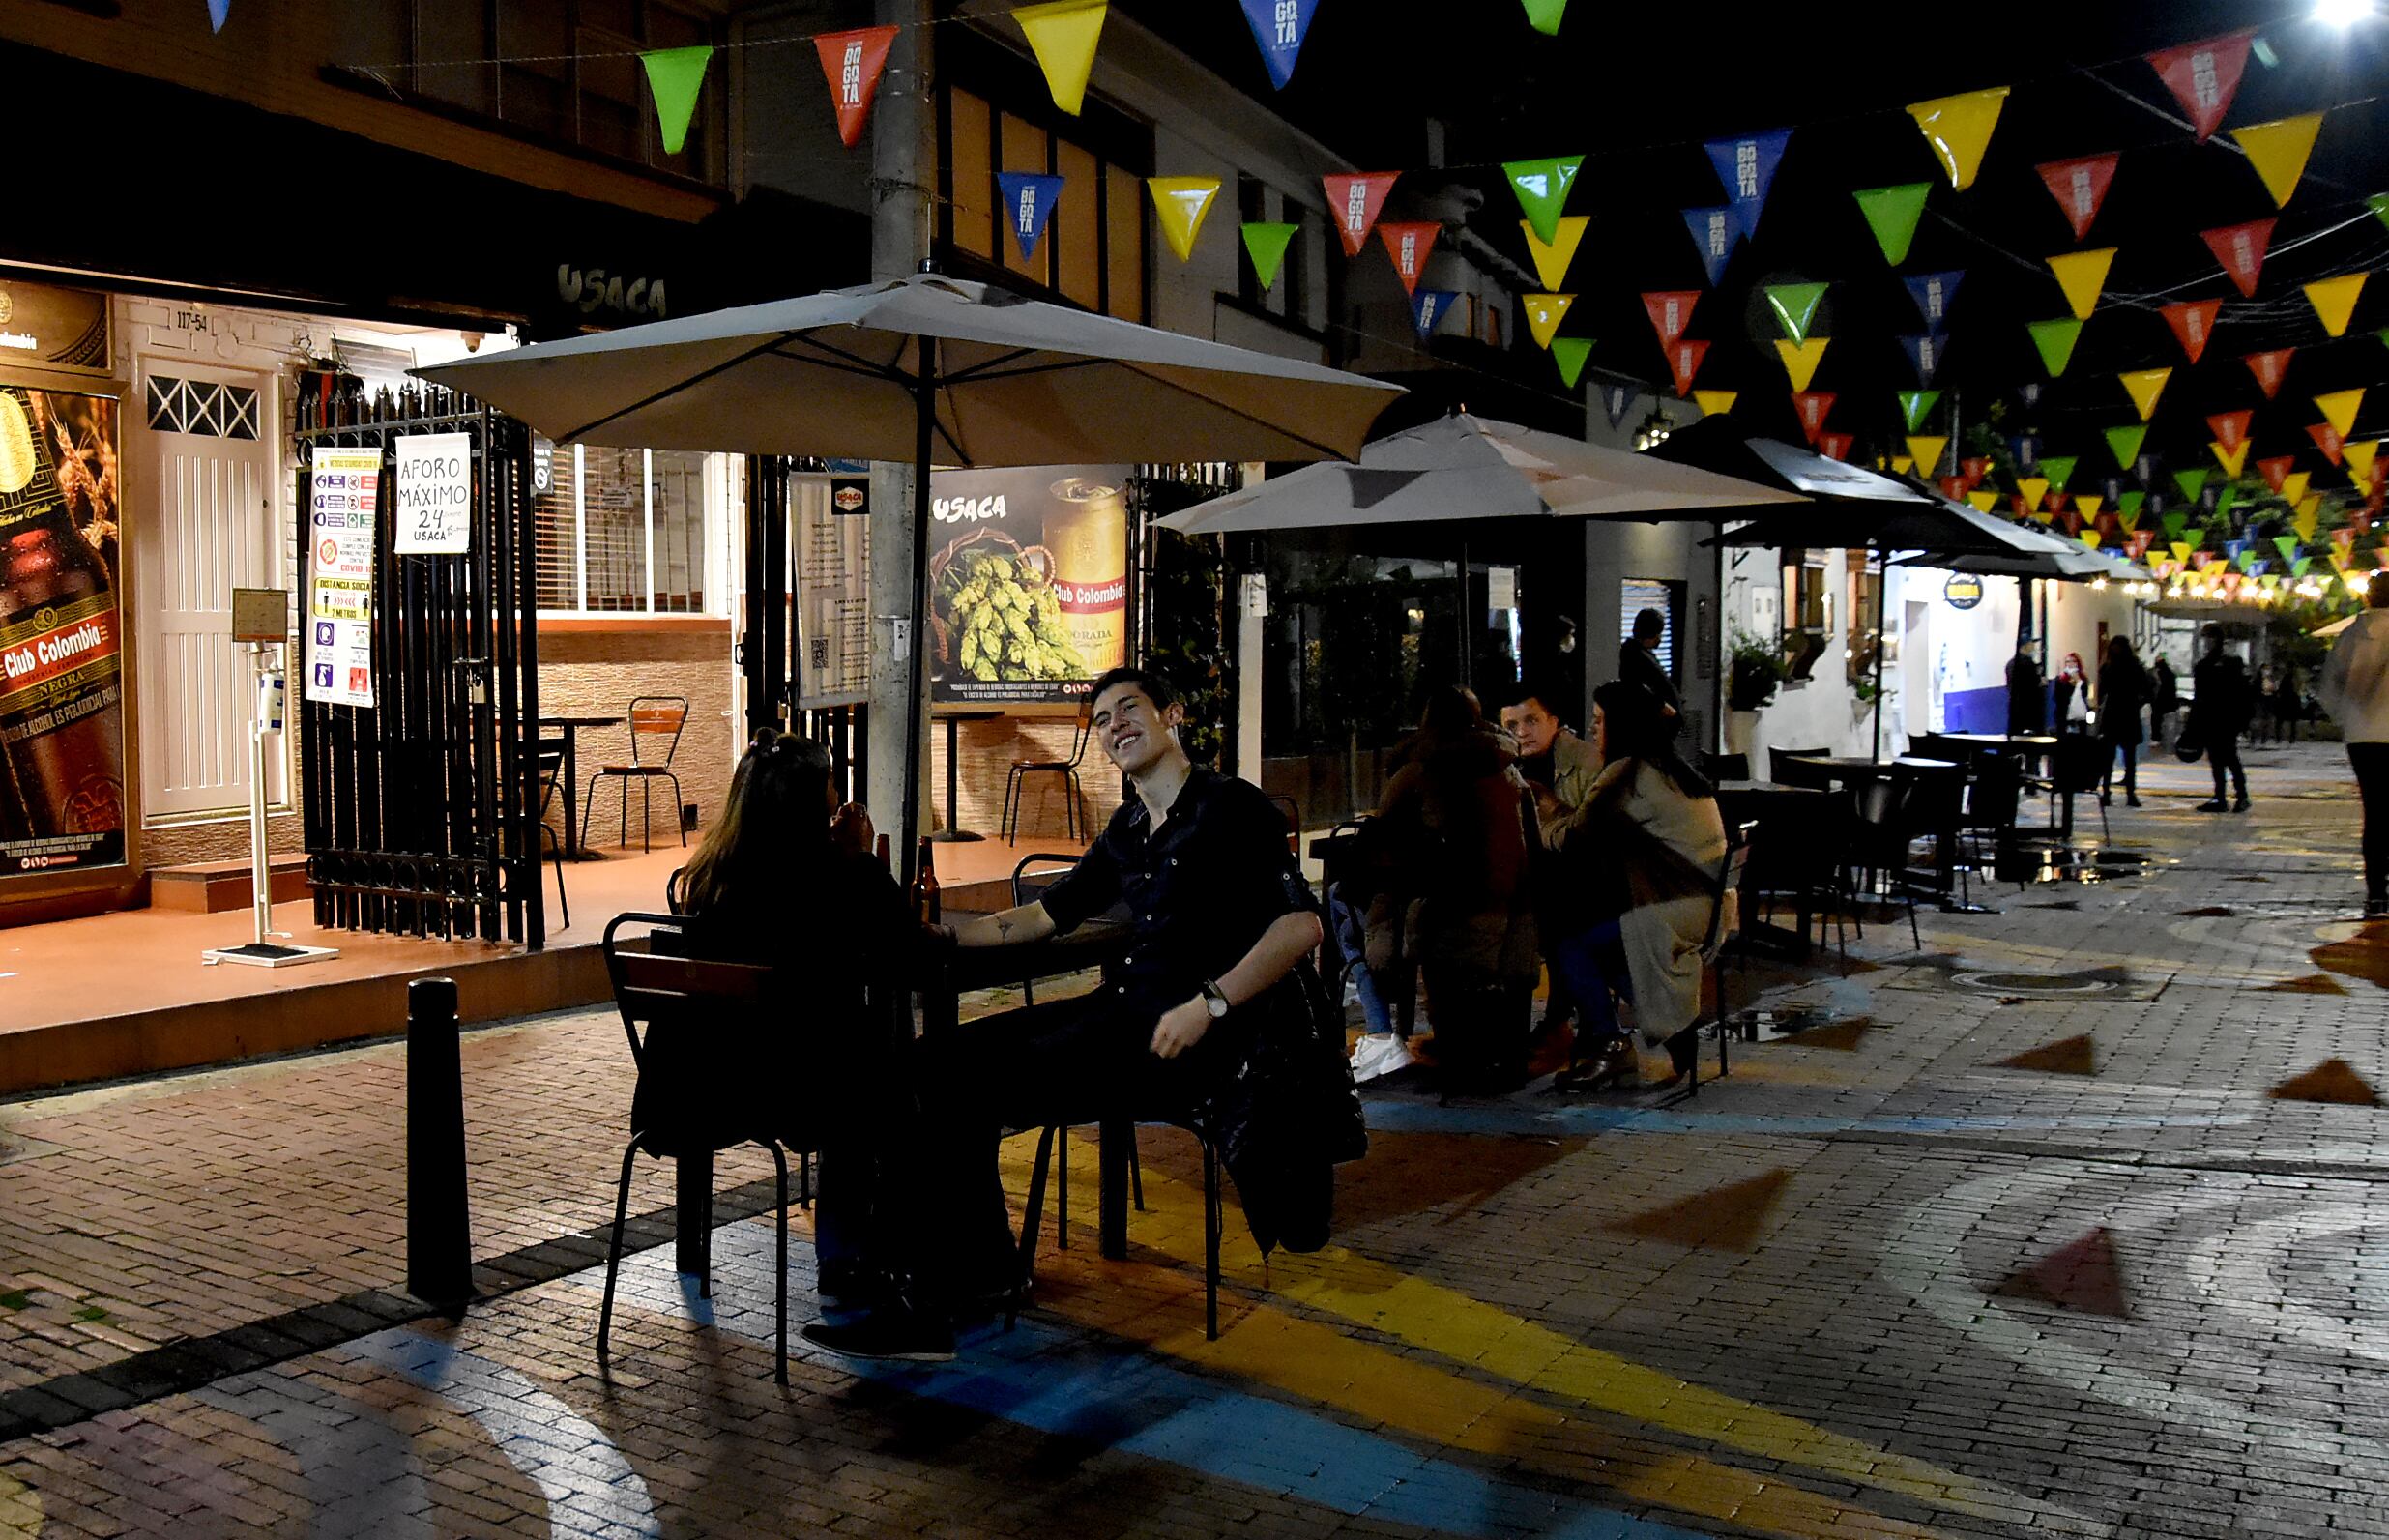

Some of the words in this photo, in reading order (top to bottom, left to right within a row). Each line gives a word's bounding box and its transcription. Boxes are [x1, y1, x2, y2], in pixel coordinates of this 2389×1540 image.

[844, 46, 861, 66] BO
[1021, 190, 1034, 204] BO
[1350, 185, 1365, 199] BO
[558, 263, 667, 318] USACA
[177, 310, 207, 333] 117-54
[401, 457, 460, 479] AFORO
[932, 494, 1006, 523] USACA
[419, 509, 443, 529] 24
[414, 531, 446, 541] USACA
[341, 564, 363, 573] COVID
[320, 580, 350, 591] DISTANCIA
[1076, 583, 1123, 604] Colombia
[336, 609, 357, 619] METROS
[4, 646, 36, 679] Club
[37, 622, 102, 666] Colombia
[38, 671, 86, 699] NEGRA
[54, 710, 65, 725] ES
